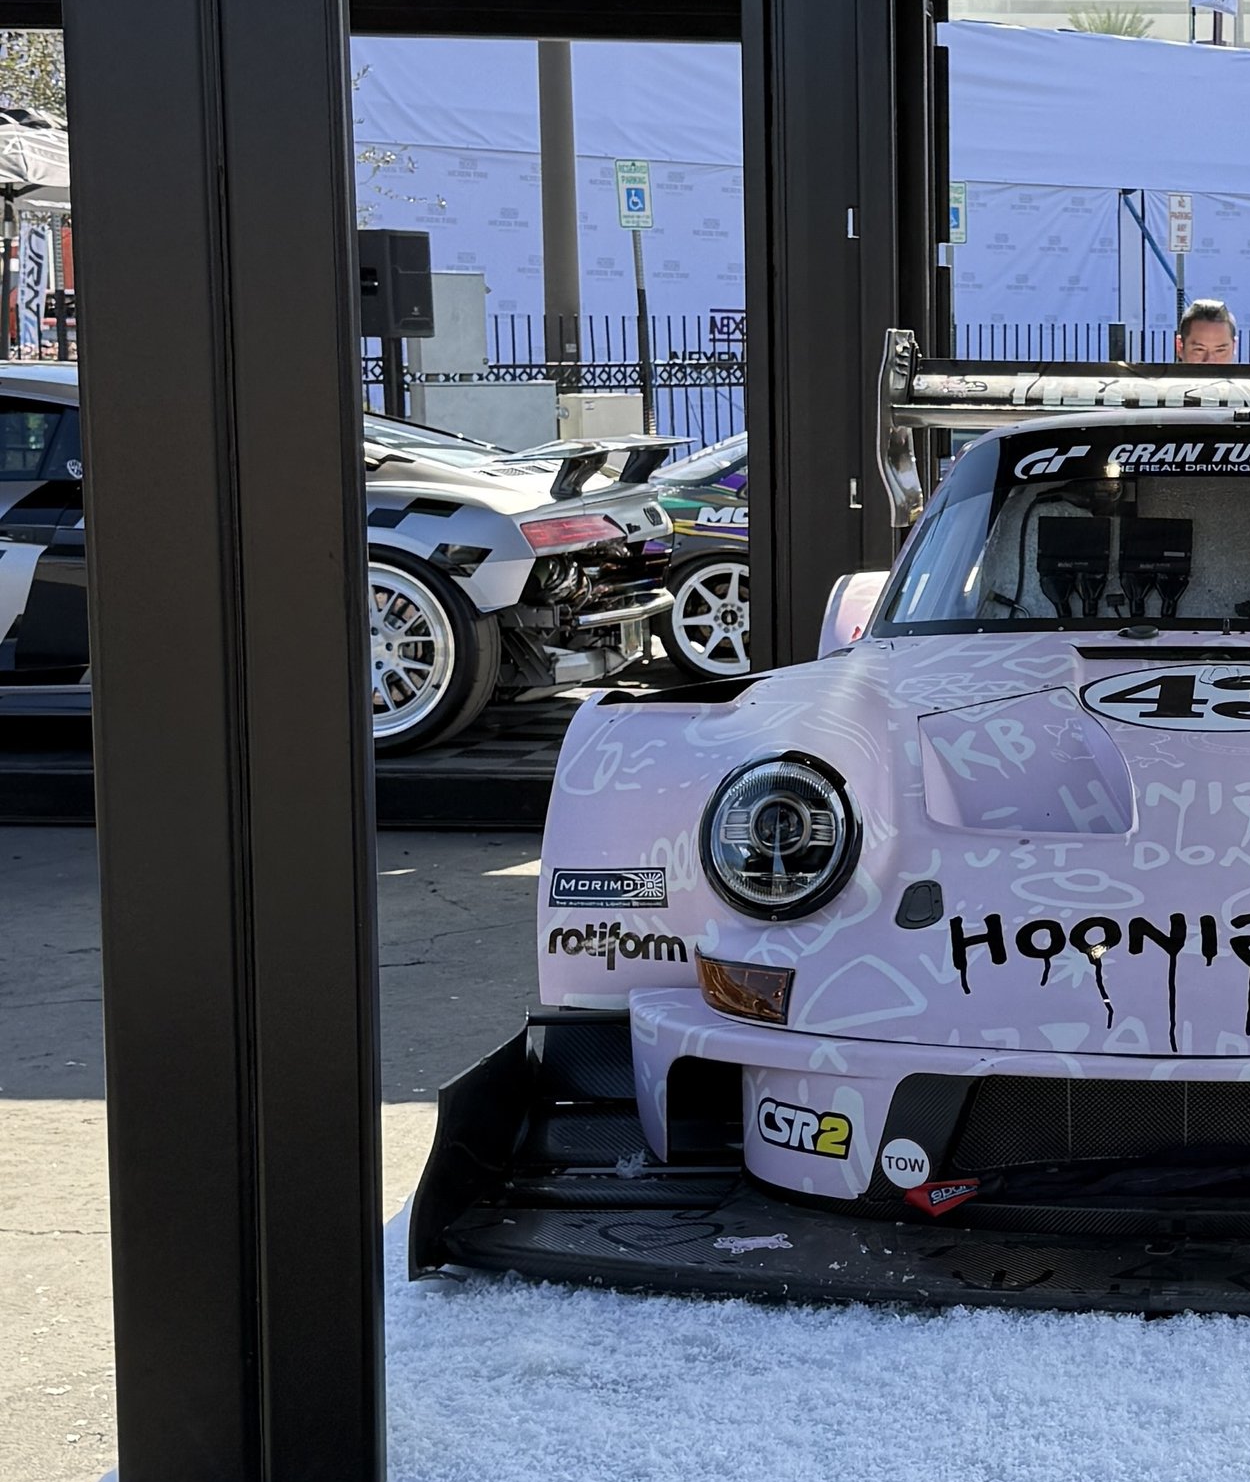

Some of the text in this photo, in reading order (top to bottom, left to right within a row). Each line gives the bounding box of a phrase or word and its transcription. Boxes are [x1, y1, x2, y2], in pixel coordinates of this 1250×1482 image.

[1107, 443, 1204, 464] GRAN
[1139, 464, 1180, 472] REAL
[1185, 463, 1250, 473] DRIVING
[560, 878, 655, 891] MORIMOTO
[548, 921, 688, 970] rotiform
[758, 1100, 850, 1156] CSR2
[884, 1154, 926, 1173] TOW
